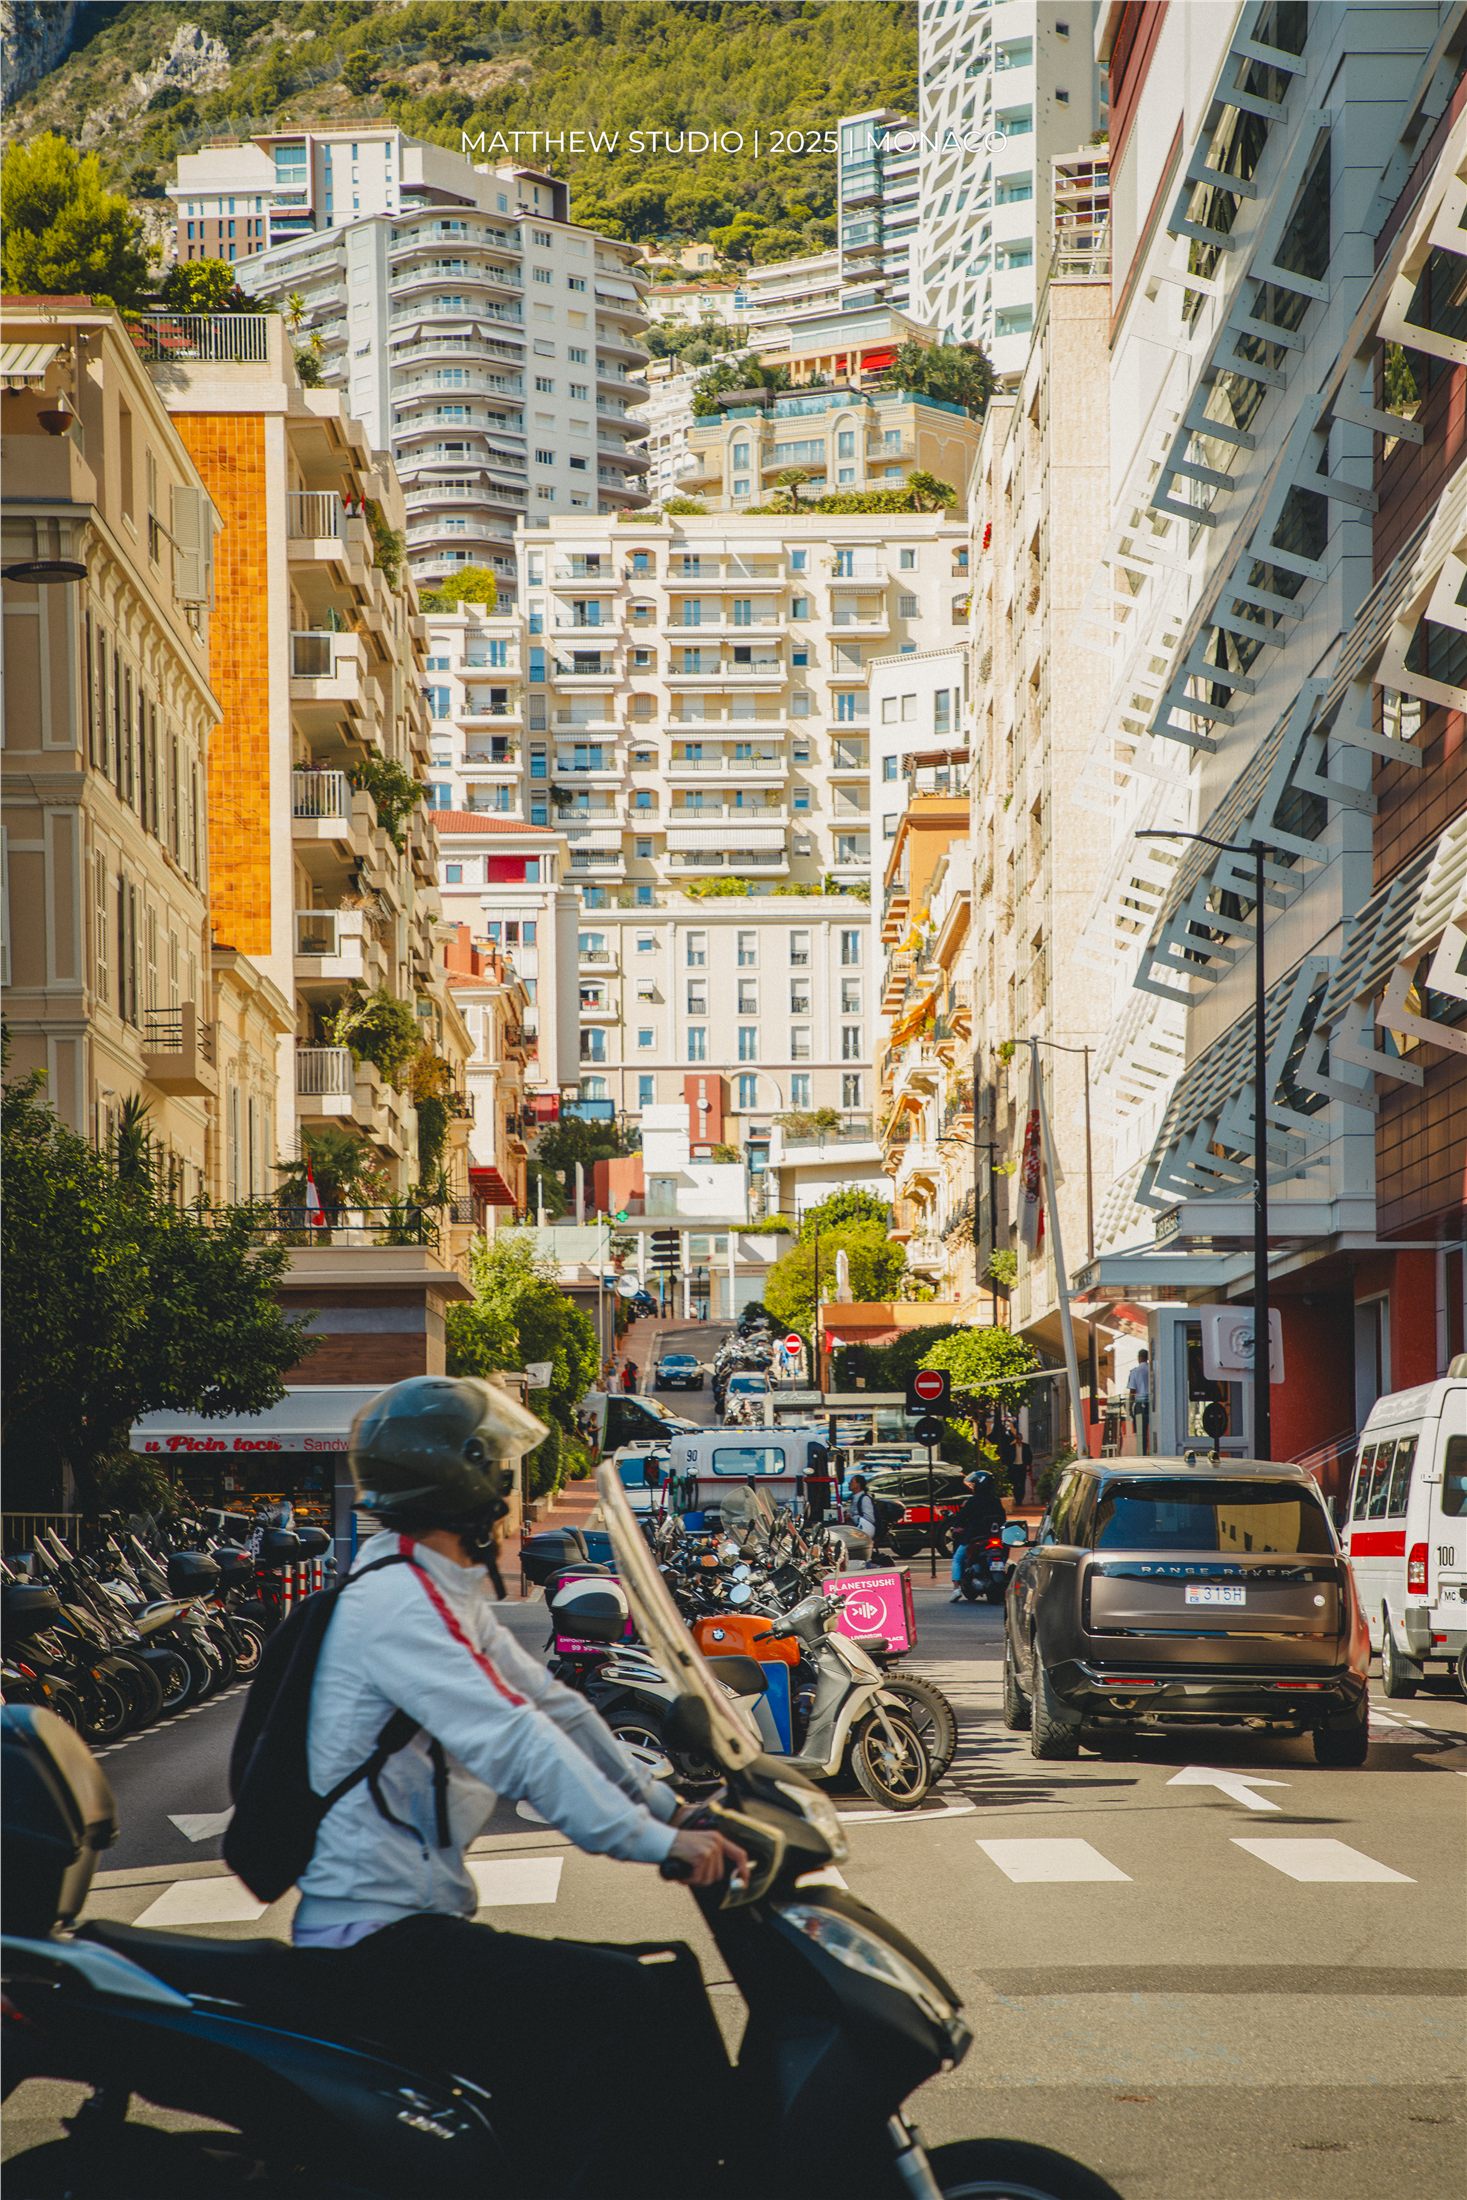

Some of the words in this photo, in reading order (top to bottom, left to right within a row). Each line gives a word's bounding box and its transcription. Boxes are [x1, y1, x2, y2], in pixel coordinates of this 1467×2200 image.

[166, 1435, 228, 1452] Picin
[687, 1450, 697, 1461] 90
[1437, 1546, 1455, 1566] 100
[1140, 1566, 1209, 1575] RANGE
[1223, 1568, 1292, 1577] ROVER
[1203, 1586, 1242, 1601] 315H
[1444, 1591, 1456, 1601] MC
